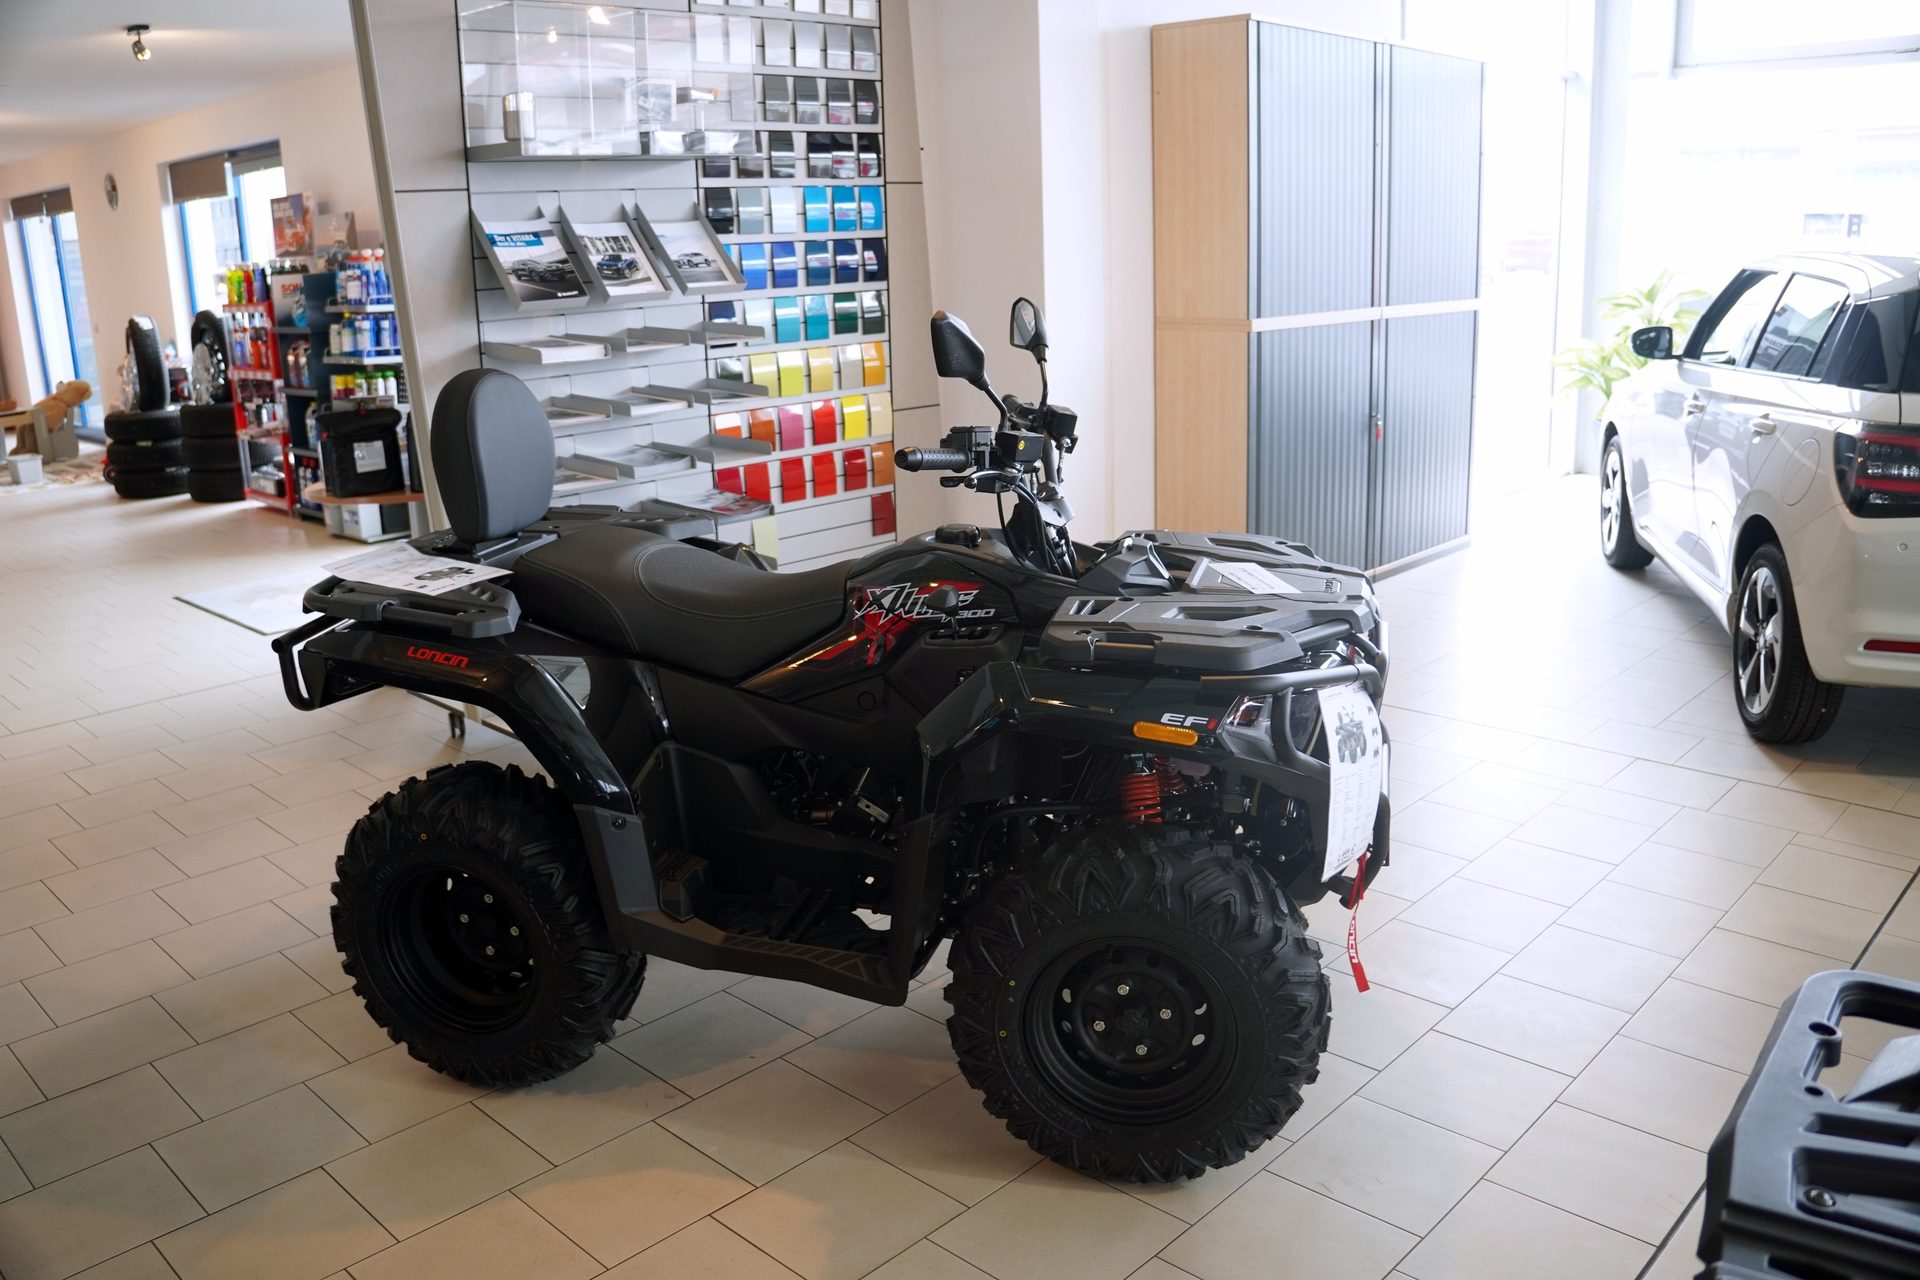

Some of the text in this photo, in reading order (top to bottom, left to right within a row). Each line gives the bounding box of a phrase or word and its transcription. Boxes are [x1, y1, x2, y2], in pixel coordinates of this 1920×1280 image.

[955, 608, 996, 619] 300
[406, 645, 469, 668] LONCIN
[1348, 918, 1359, 964] ONCIN
